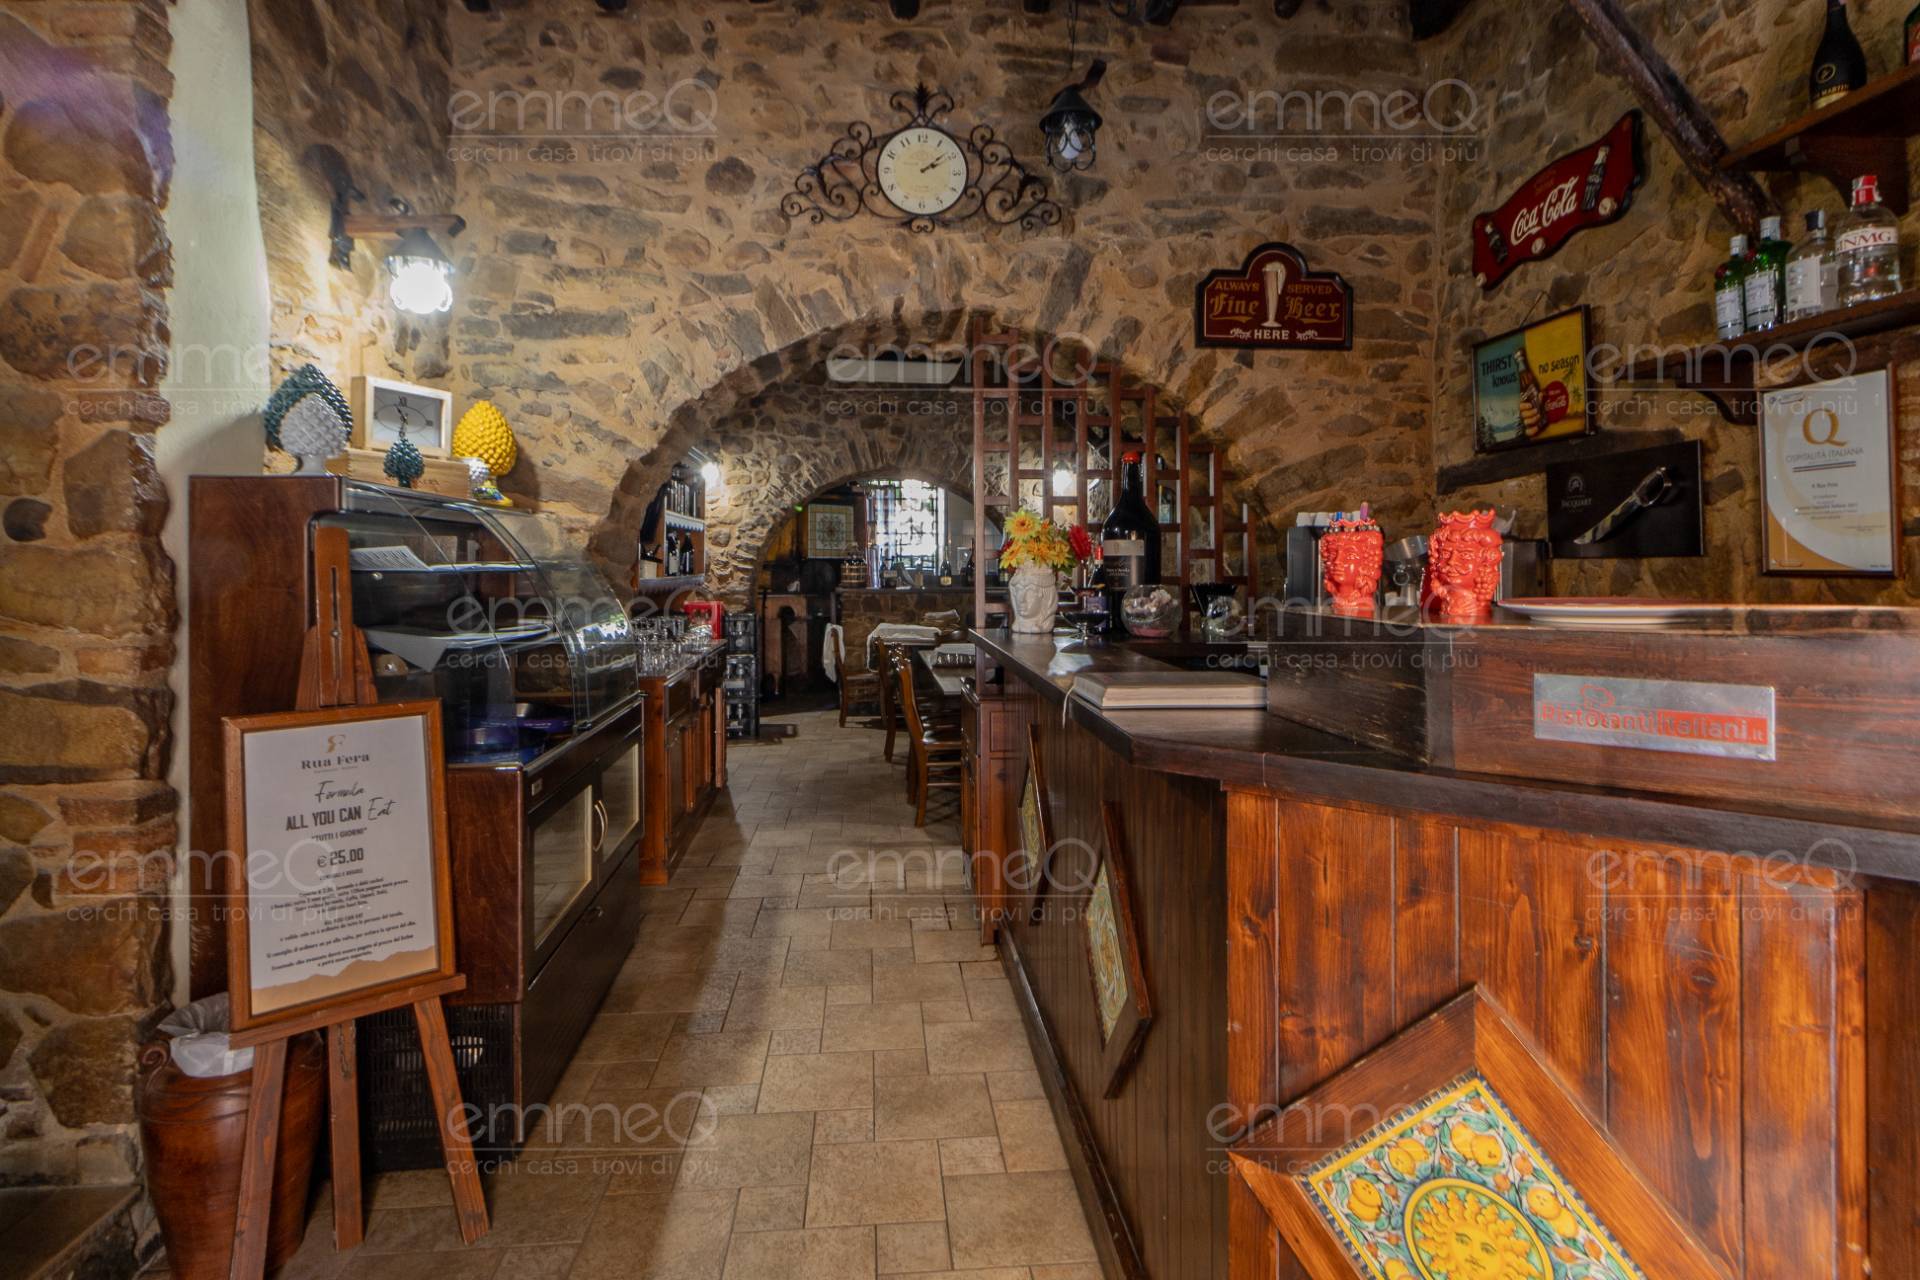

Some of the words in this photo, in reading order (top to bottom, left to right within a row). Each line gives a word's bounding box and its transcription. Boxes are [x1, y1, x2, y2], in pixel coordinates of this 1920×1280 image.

[1837, 231, 1892, 252] INMG
[1215, 281, 1260, 293] ALWAYS
[1287, 283, 1333, 295] SERVED
[1209, 292, 1260, 318] Fine
[1284, 295, 1341, 320] Beer
[1254, 329, 1290, 340] HERE
[1480, 354, 1513, 376] THIRST
[1538, 362, 1549, 375] no
[1551, 354, 1580, 372] season
[1802, 408, 1848, 447] Q
[301, 757, 331, 770] Rua
[337, 753, 370, 766] Fera
[314, 780, 365, 803] Formula
[286, 814, 308, 831] ALL
[312, 810, 335, 827] YOU
[339, 805, 362, 822] CAN
[367, 796, 397, 821] Eat
